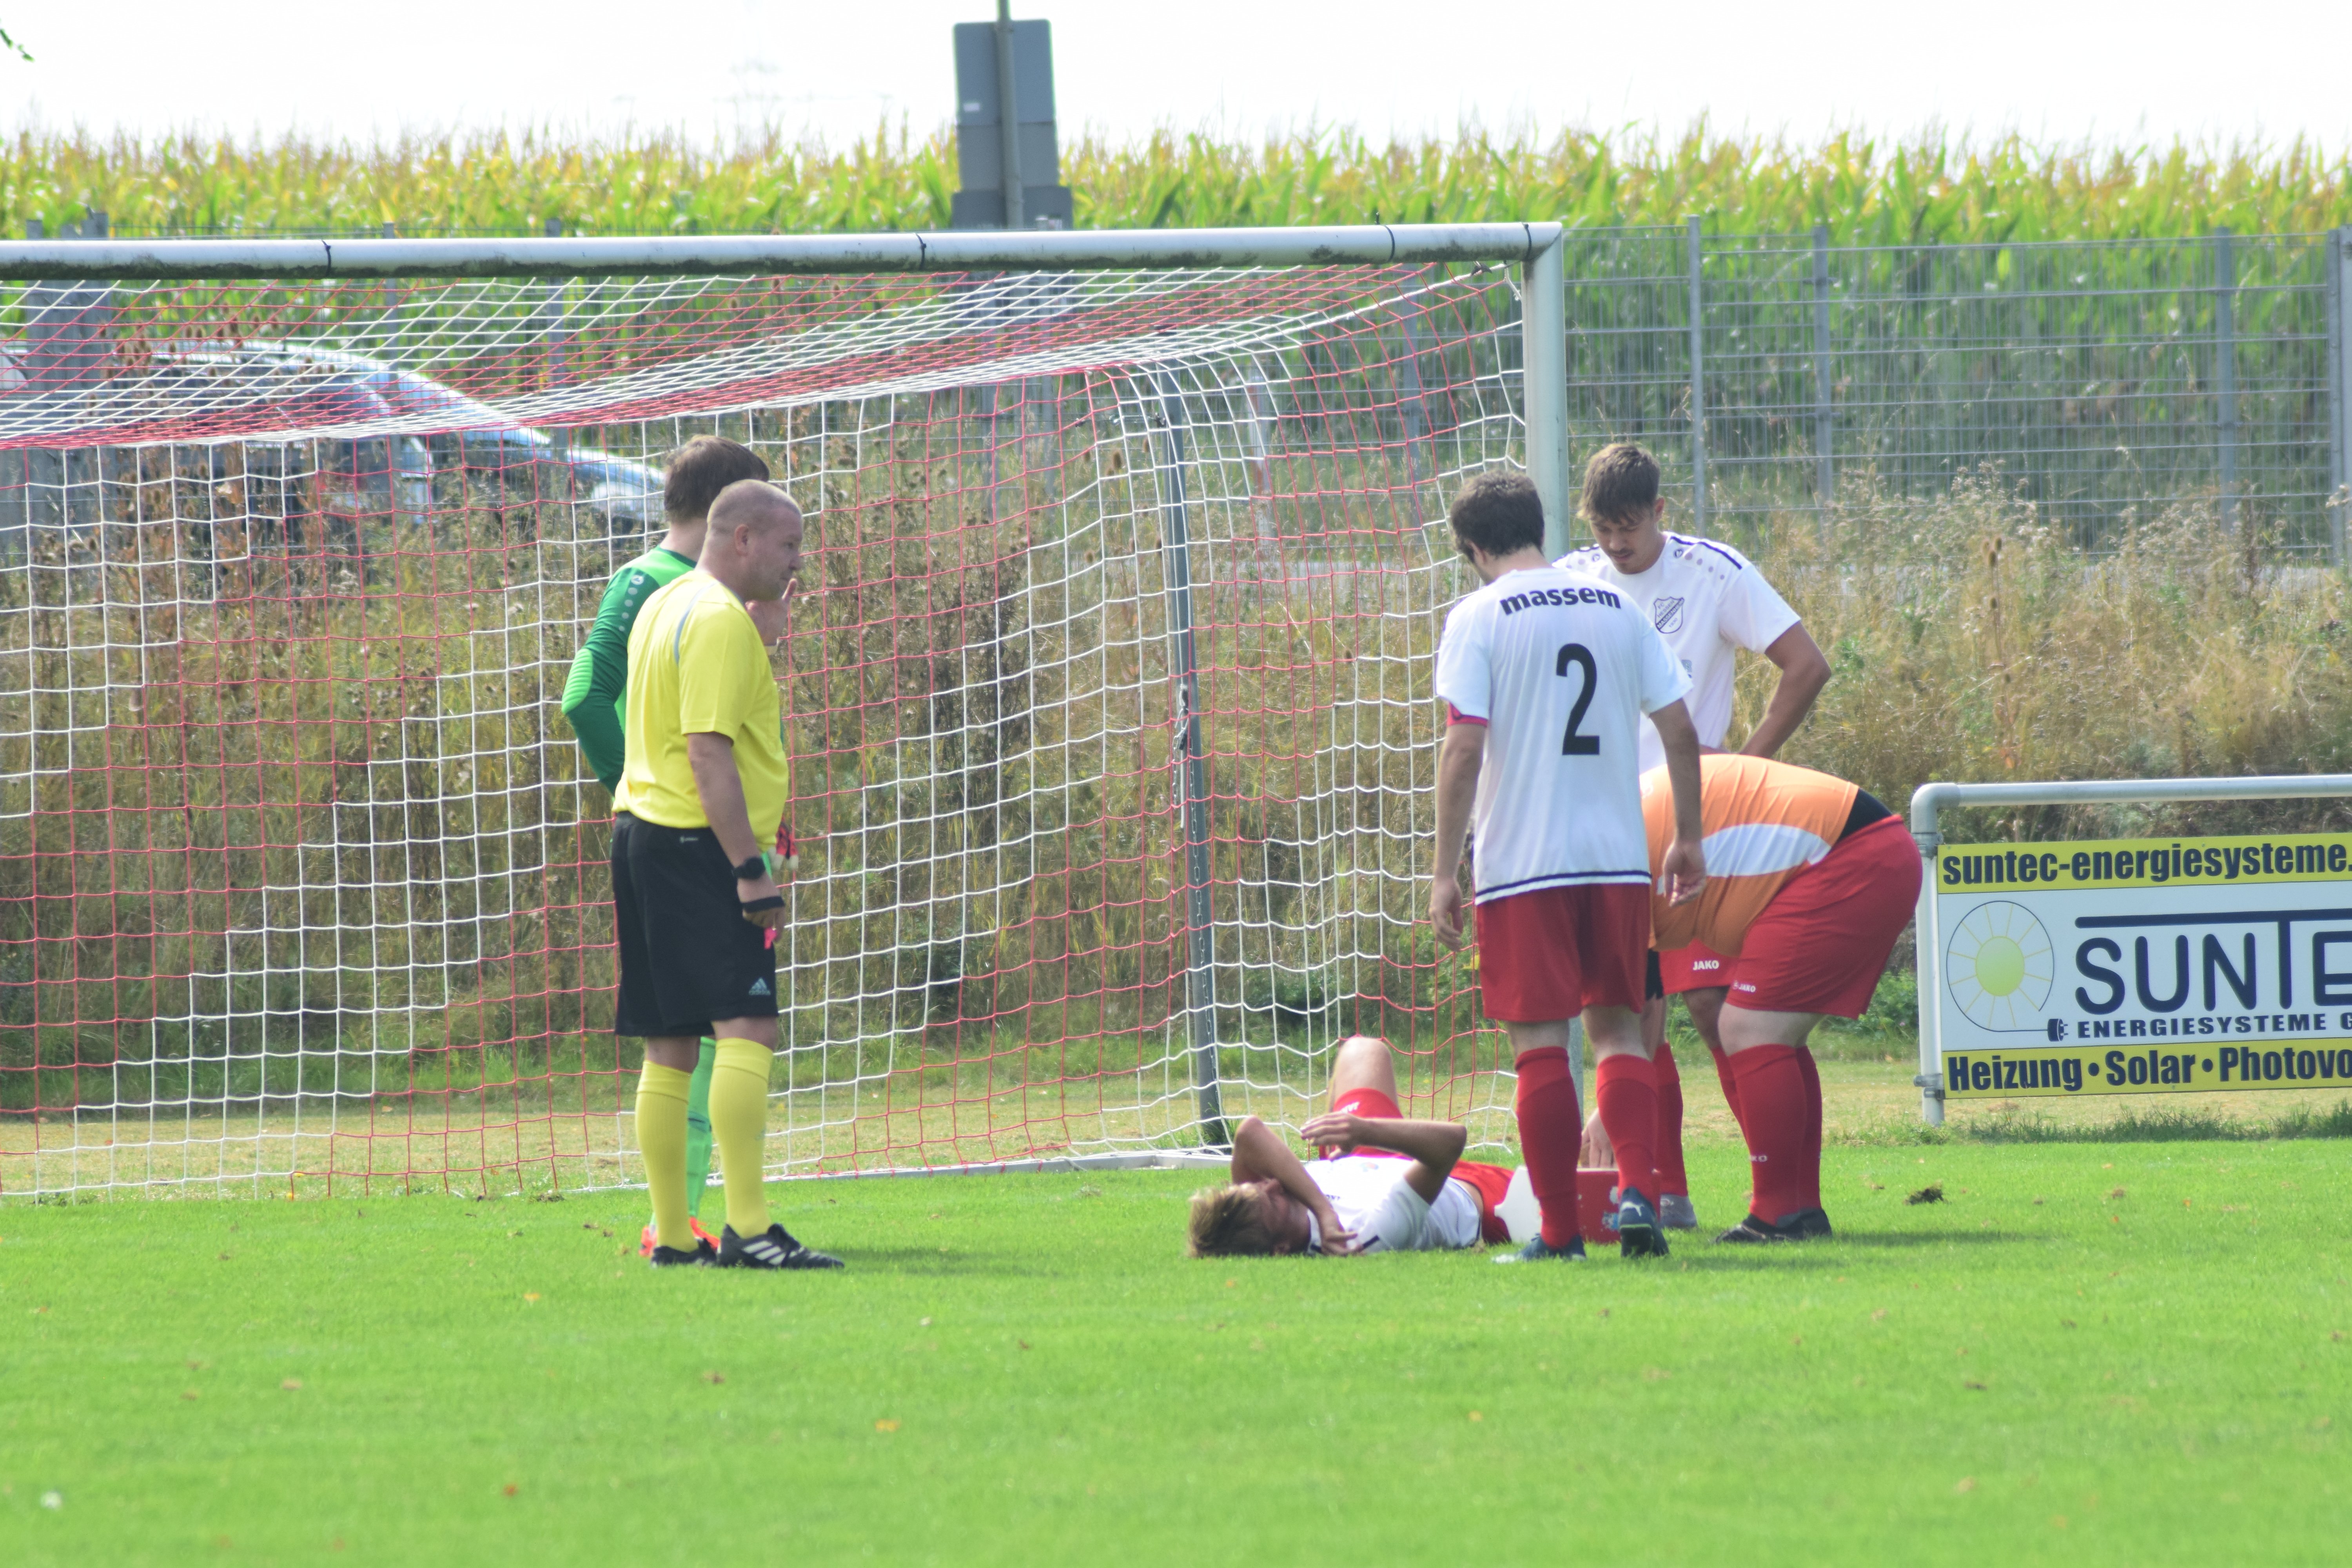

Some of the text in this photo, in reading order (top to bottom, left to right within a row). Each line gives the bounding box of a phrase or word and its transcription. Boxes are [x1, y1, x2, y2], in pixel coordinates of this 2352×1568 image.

[1500, 588, 1621, 615] massem
[1556, 643, 1600, 756] 2
[1693, 960, 1719, 971] JAKO
[1739, 984, 1756, 993] JAKO
[2078, 1013, 2327, 1039] ENERGIESYSTEME
[1947, 1046, 2352, 1092] Heizung Solar Photovo
